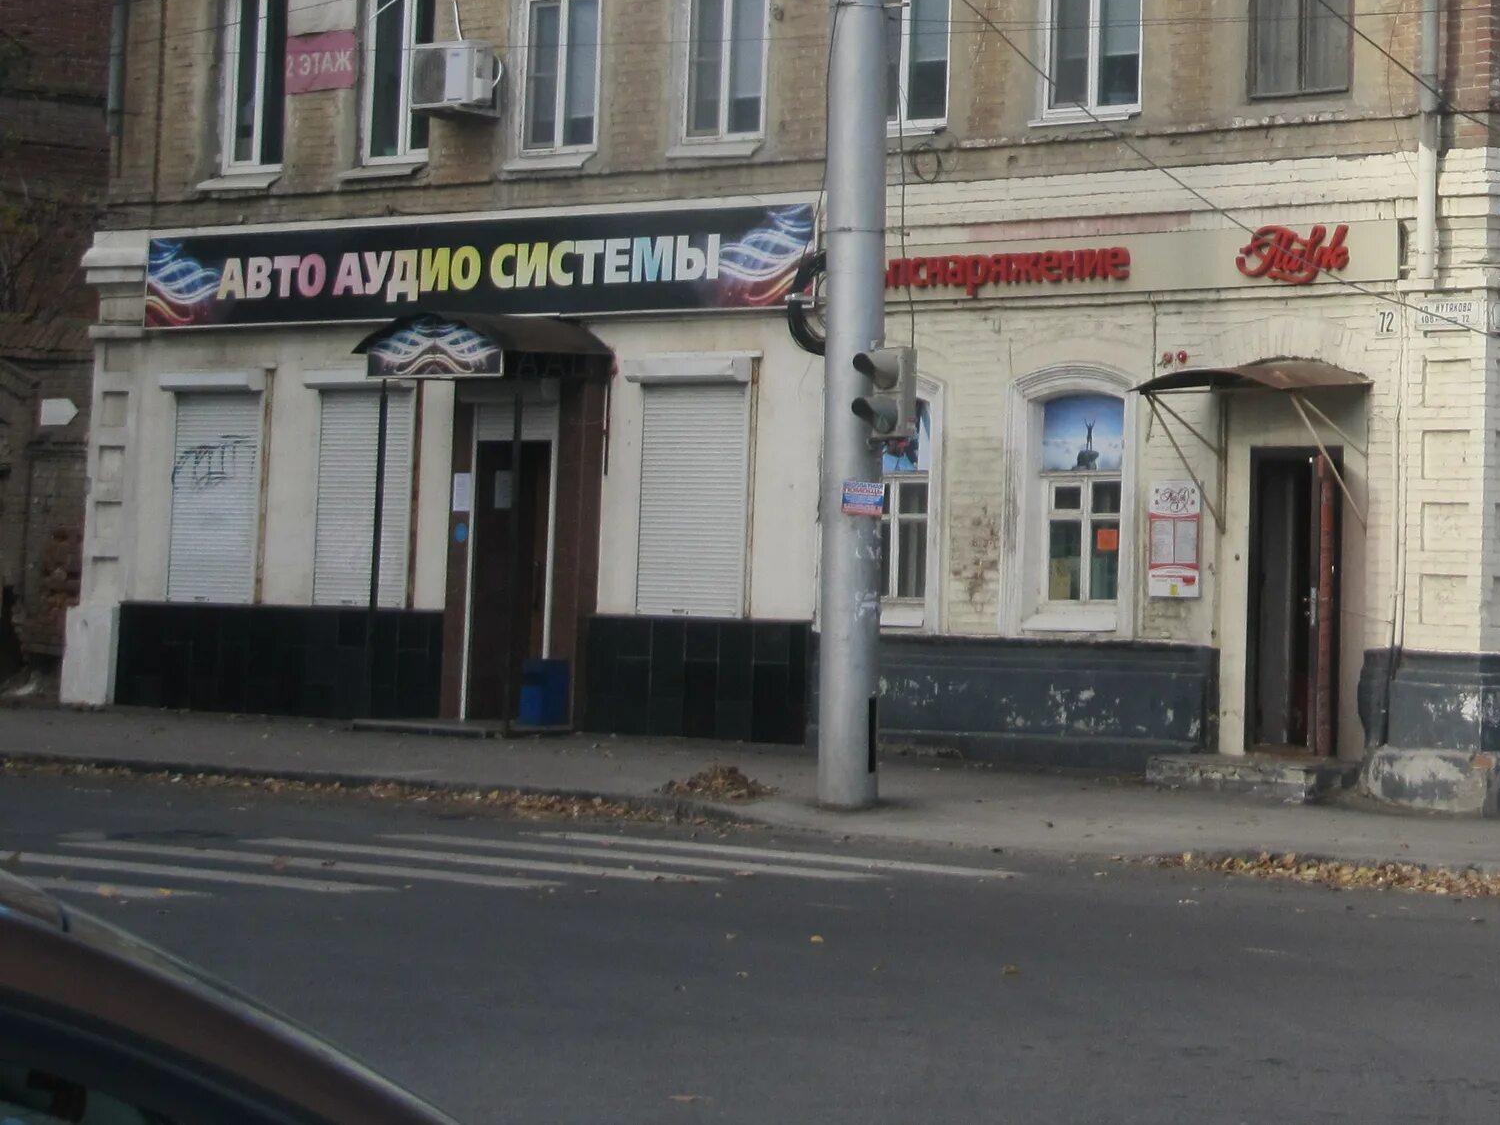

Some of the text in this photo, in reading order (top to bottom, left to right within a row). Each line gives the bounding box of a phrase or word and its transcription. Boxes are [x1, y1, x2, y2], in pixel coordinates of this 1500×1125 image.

[300, 49, 353, 75] ЭТАЖ
[216, 233, 721, 303] АВТО АУДИО СИСТЕМЫ
[1379, 311, 1394, 333] 72
